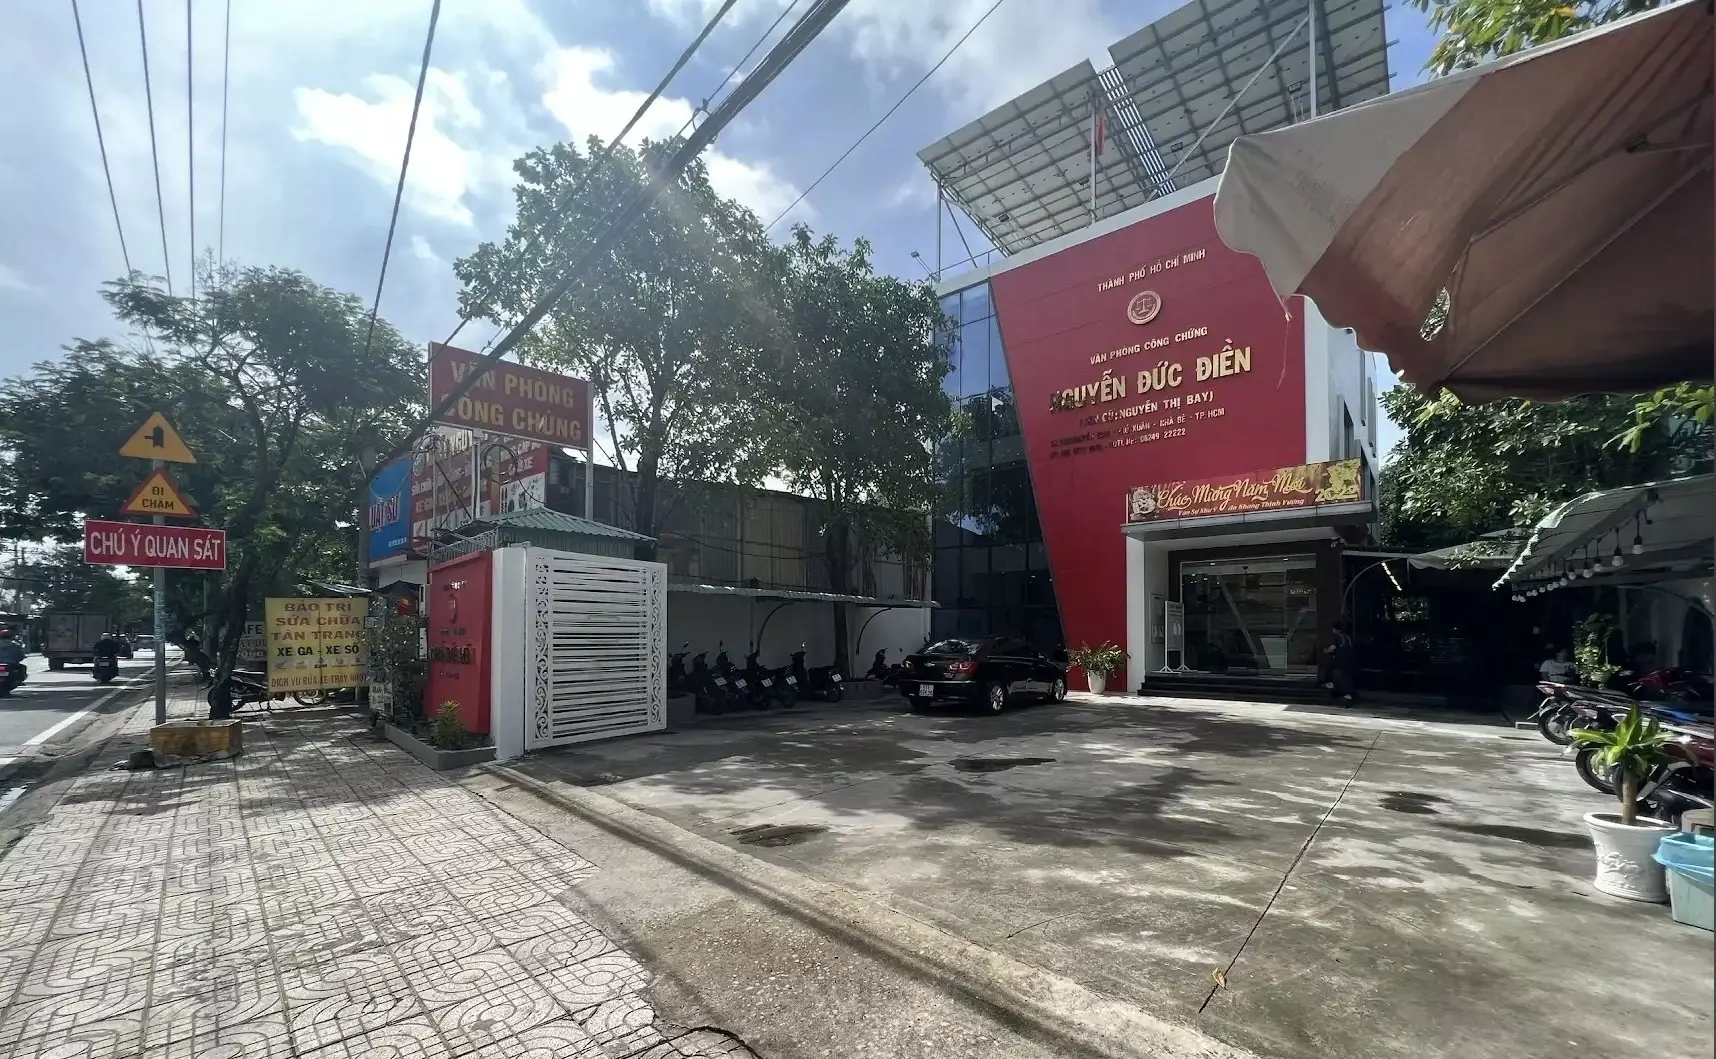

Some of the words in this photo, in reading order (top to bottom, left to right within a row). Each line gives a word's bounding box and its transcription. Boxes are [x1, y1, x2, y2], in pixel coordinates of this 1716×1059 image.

[1097, 276, 1125, 292] THÀNH
[1165, 255, 1180, 270] CHÍ
[1183, 248, 1206, 264] MINH
[1090, 352, 1107, 365] VĂN
[1144, 336, 1170, 351] CÔNG
[1175, 326, 1209, 342] CHỨNG
[1137, 361, 1183, 394] ĐỨC
[1196, 338, 1251, 382] ĐIỀN
[504, 372, 574, 408] PHÒNG
[1163, 397, 1181, 411] THỊ
[1207, 407, 1226, 418] HCM
[1164, 428, 1187, 440] 22222
[151, 486, 164, 496] ĐI
[1218, 478, 1269, 501] Năm
[90, 528, 125, 556] CHÚ
[131, 529, 141, 556] Ý
[144, 535, 189, 559] QUAN
[193, 534, 221, 560] SÁT
[276, 647, 293, 657] XE
[297, 646, 313, 656] GA
[325, 645, 341, 655] XE
[344, 640, 360, 654] SỐ
